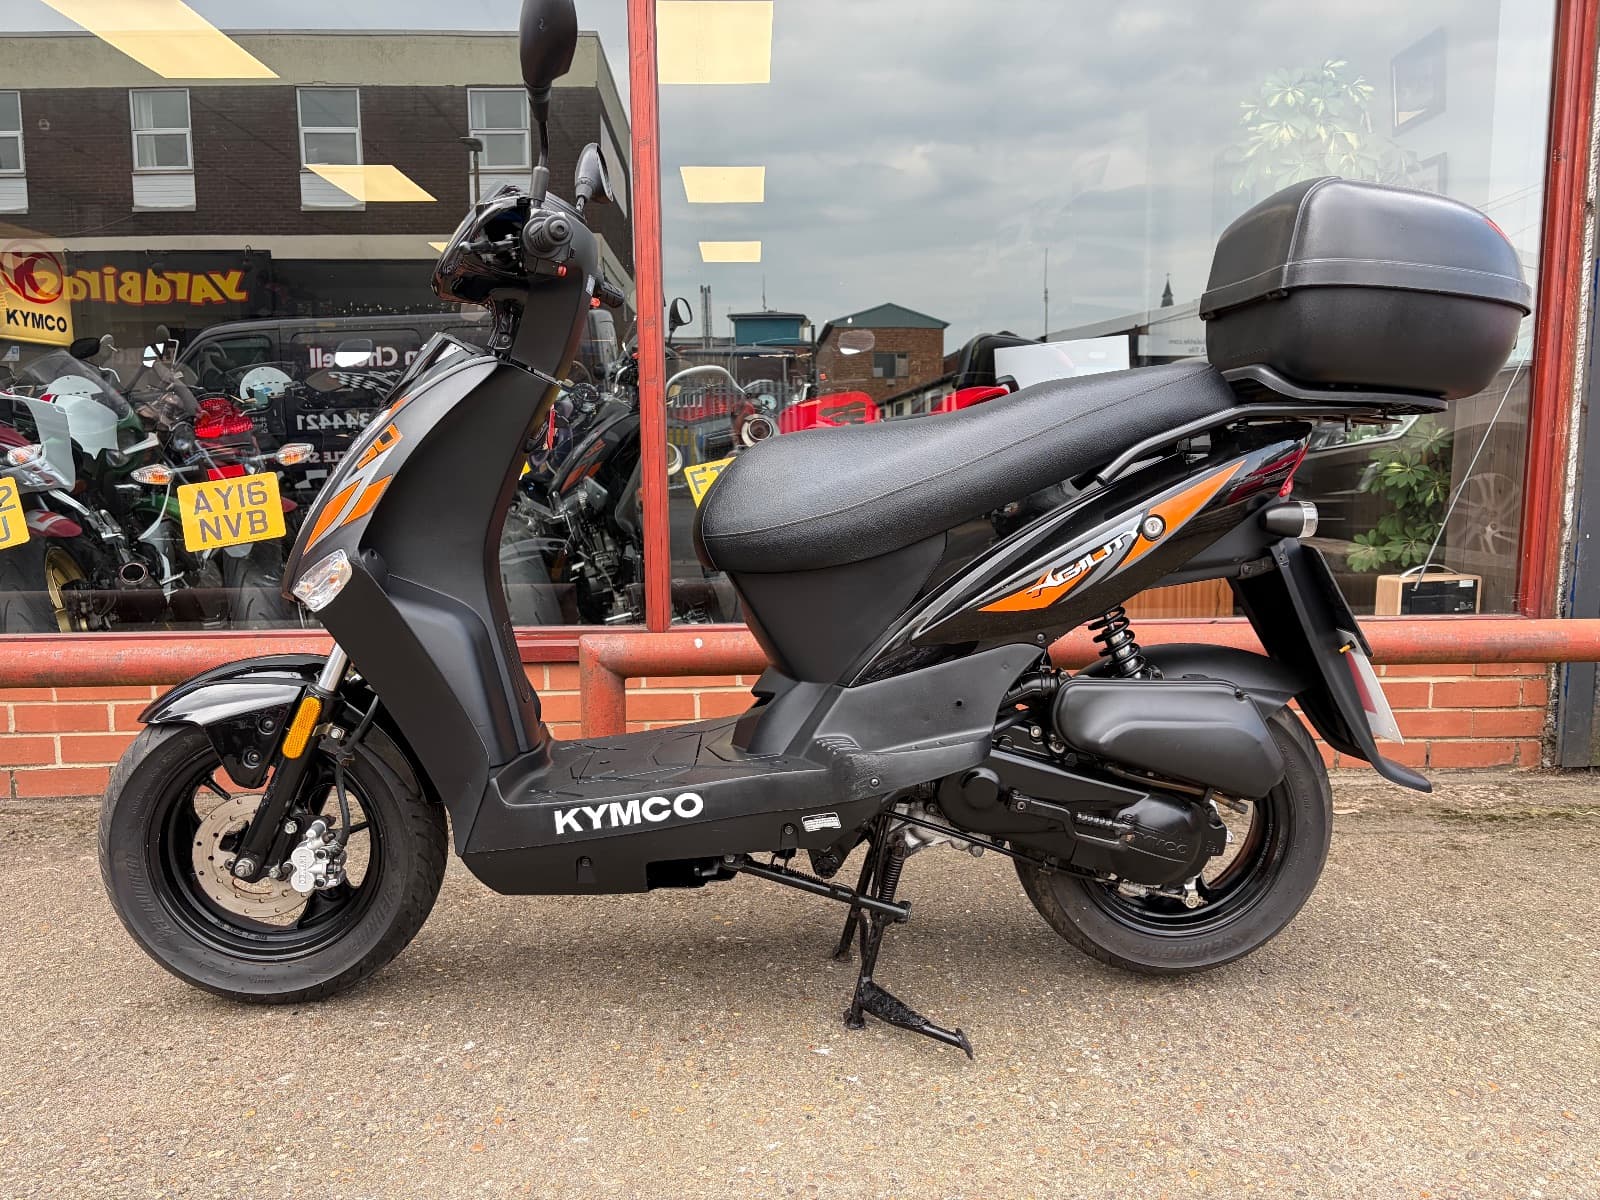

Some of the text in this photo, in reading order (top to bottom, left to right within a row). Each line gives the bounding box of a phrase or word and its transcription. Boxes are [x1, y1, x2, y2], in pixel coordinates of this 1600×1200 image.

[6, 308, 67, 333] KYMCO
[193, 480, 269, 515] AY16
[199, 509, 269, 544] NVB
[553, 792, 704, 835] KYMCO
